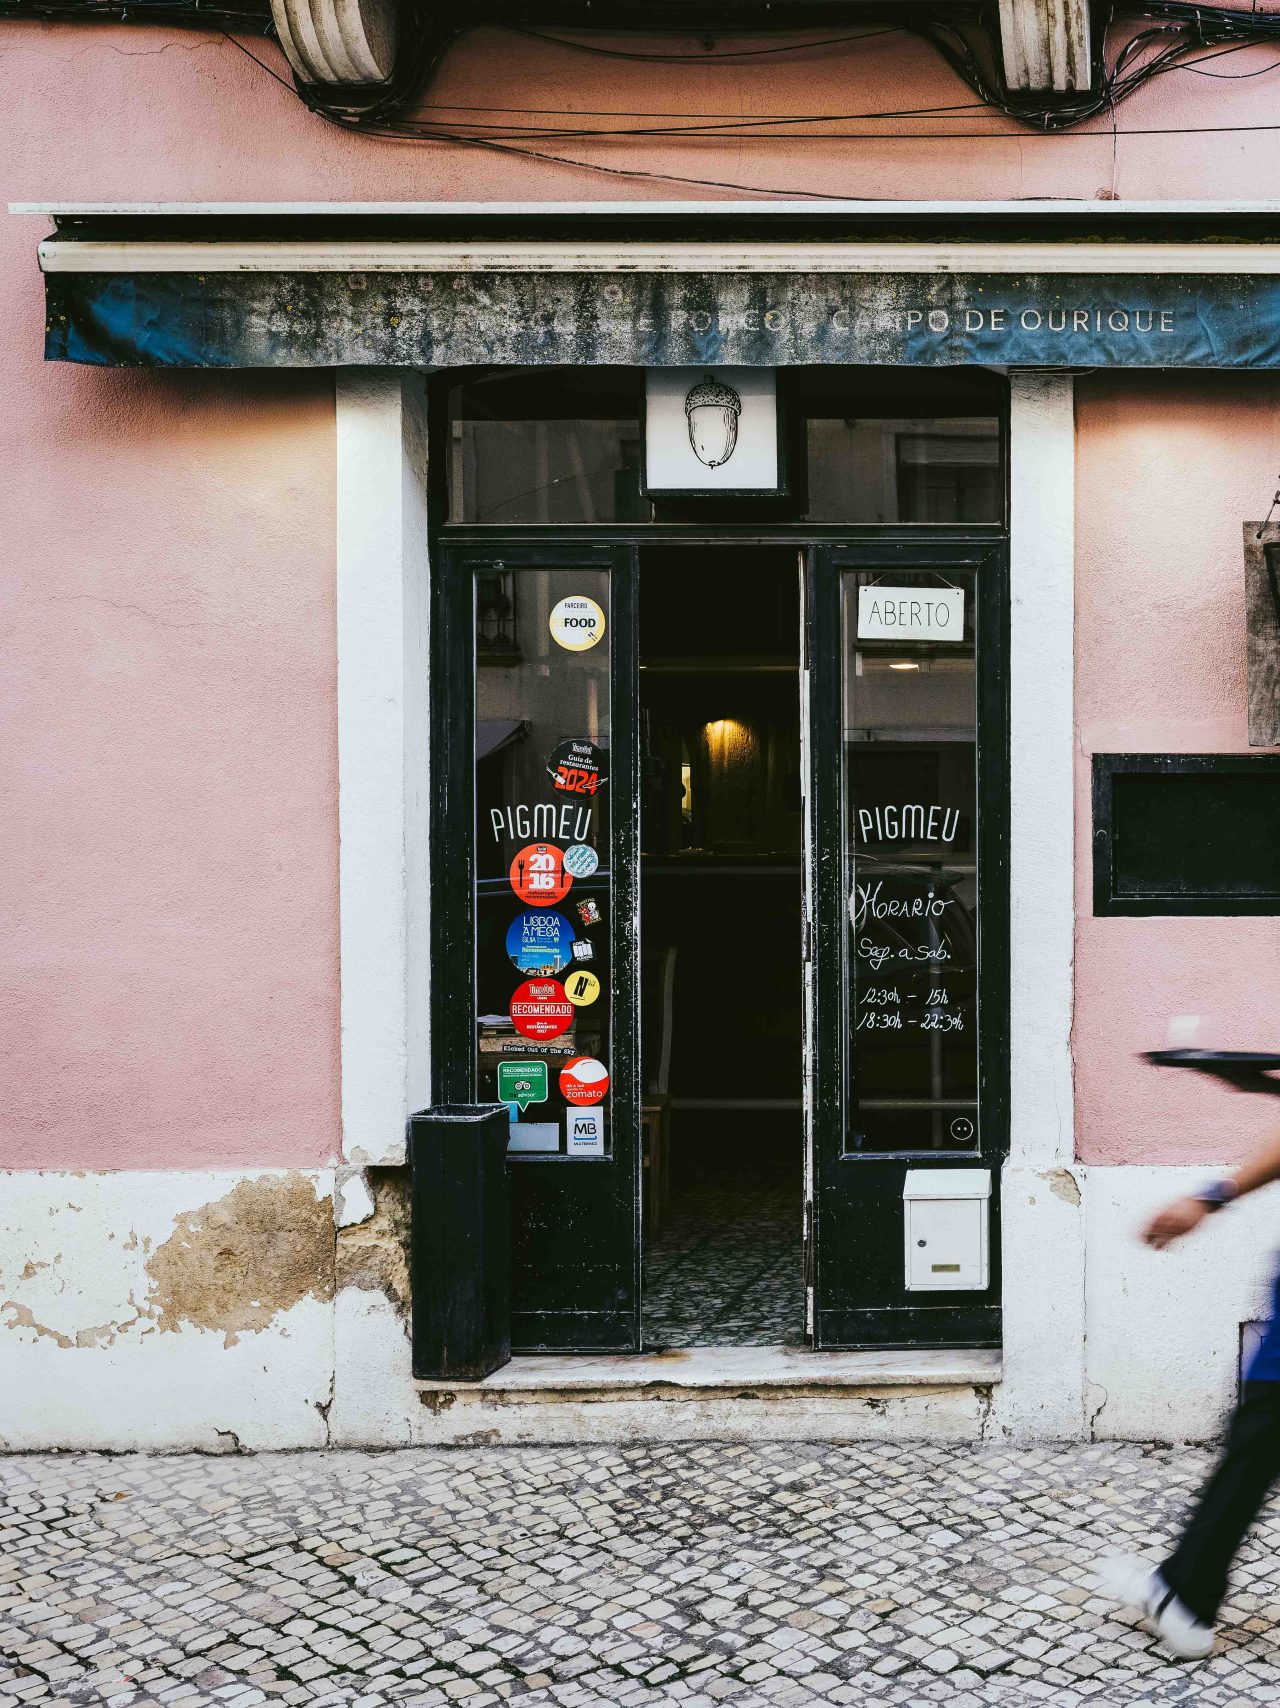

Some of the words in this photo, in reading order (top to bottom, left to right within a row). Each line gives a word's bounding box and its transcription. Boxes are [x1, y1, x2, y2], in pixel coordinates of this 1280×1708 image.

[965, 309, 1005, 332] DE
[1020, 308, 1175, 333] OURIQUE
[868, 600, 950, 628] ABERTO
[564, 617, 596, 628] FOOD
[554, 766, 598, 795] 2024
[490, 803, 592, 843] PIGMEU
[858, 804, 960, 843] PIGMEU
[523, 916, 560, 926] LISBOA
[530, 927, 560, 937] MESA
[511, 1004, 573, 1014] RECOMENDADO
[566, 1090, 603, 1098] zomato
[573, 1123, 597, 1135] MB
